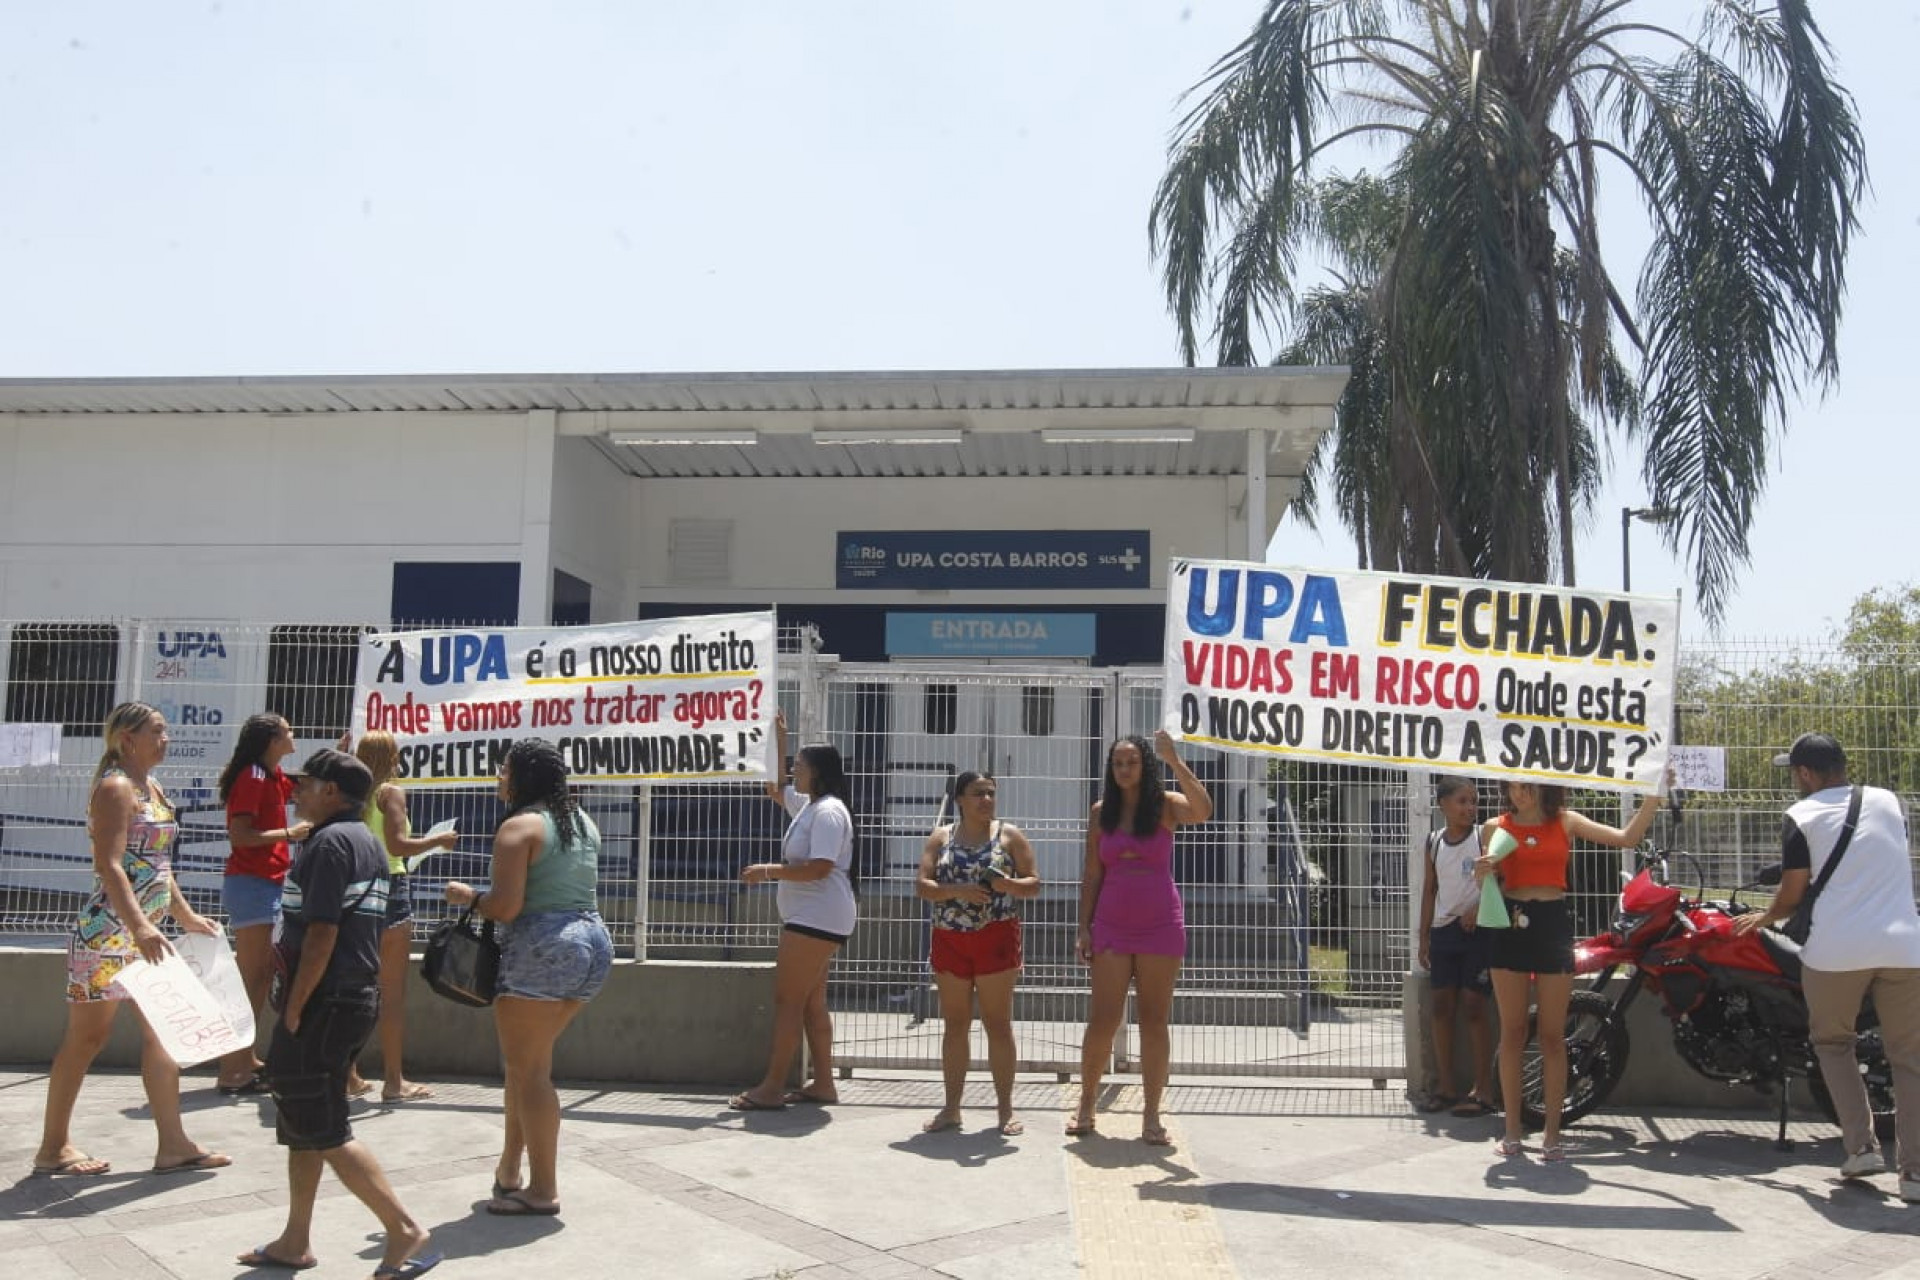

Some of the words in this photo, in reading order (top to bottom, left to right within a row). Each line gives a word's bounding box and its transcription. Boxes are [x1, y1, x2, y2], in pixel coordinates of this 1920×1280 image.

[860, 545, 886, 560] Rio
[896, 552, 934, 568] UPA
[939, 552, 1007, 568] COSTA
[1009, 552, 1088, 568] BARROS
[931, 620, 1048, 640] ENTRADA
[1378, 581, 1658, 664] FECHADA:
[158, 631, 227, 659] UPA
[420, 634, 510, 685] UPA
[526, 640, 547, 678] é
[589, 643, 662, 677] nosso
[670, 630, 759, 674] direito.
[1183, 639, 1293, 694] VIDAS
[1310, 651, 1360, 701] EM
[1375, 656, 1487, 711] RISCO.
[1495, 667, 1568, 717] Onde
[1577, 677, 1652, 726] está
[182, 703, 223, 726] Rio
[366, 691, 430, 735] Onde
[441, 699, 523, 733] vamos
[531, 697, 575, 728] nos
[583, 684, 666, 726] tratar
[673, 679, 764, 730] agora?
[1181, 692, 1199, 735] O
[1208, 696, 1304, 747] NOSSO
[1322, 707, 1443, 760] DIREITO
[1459, 720, 1486, 764] A
[558, 733, 726, 776] COMUNIDADE
